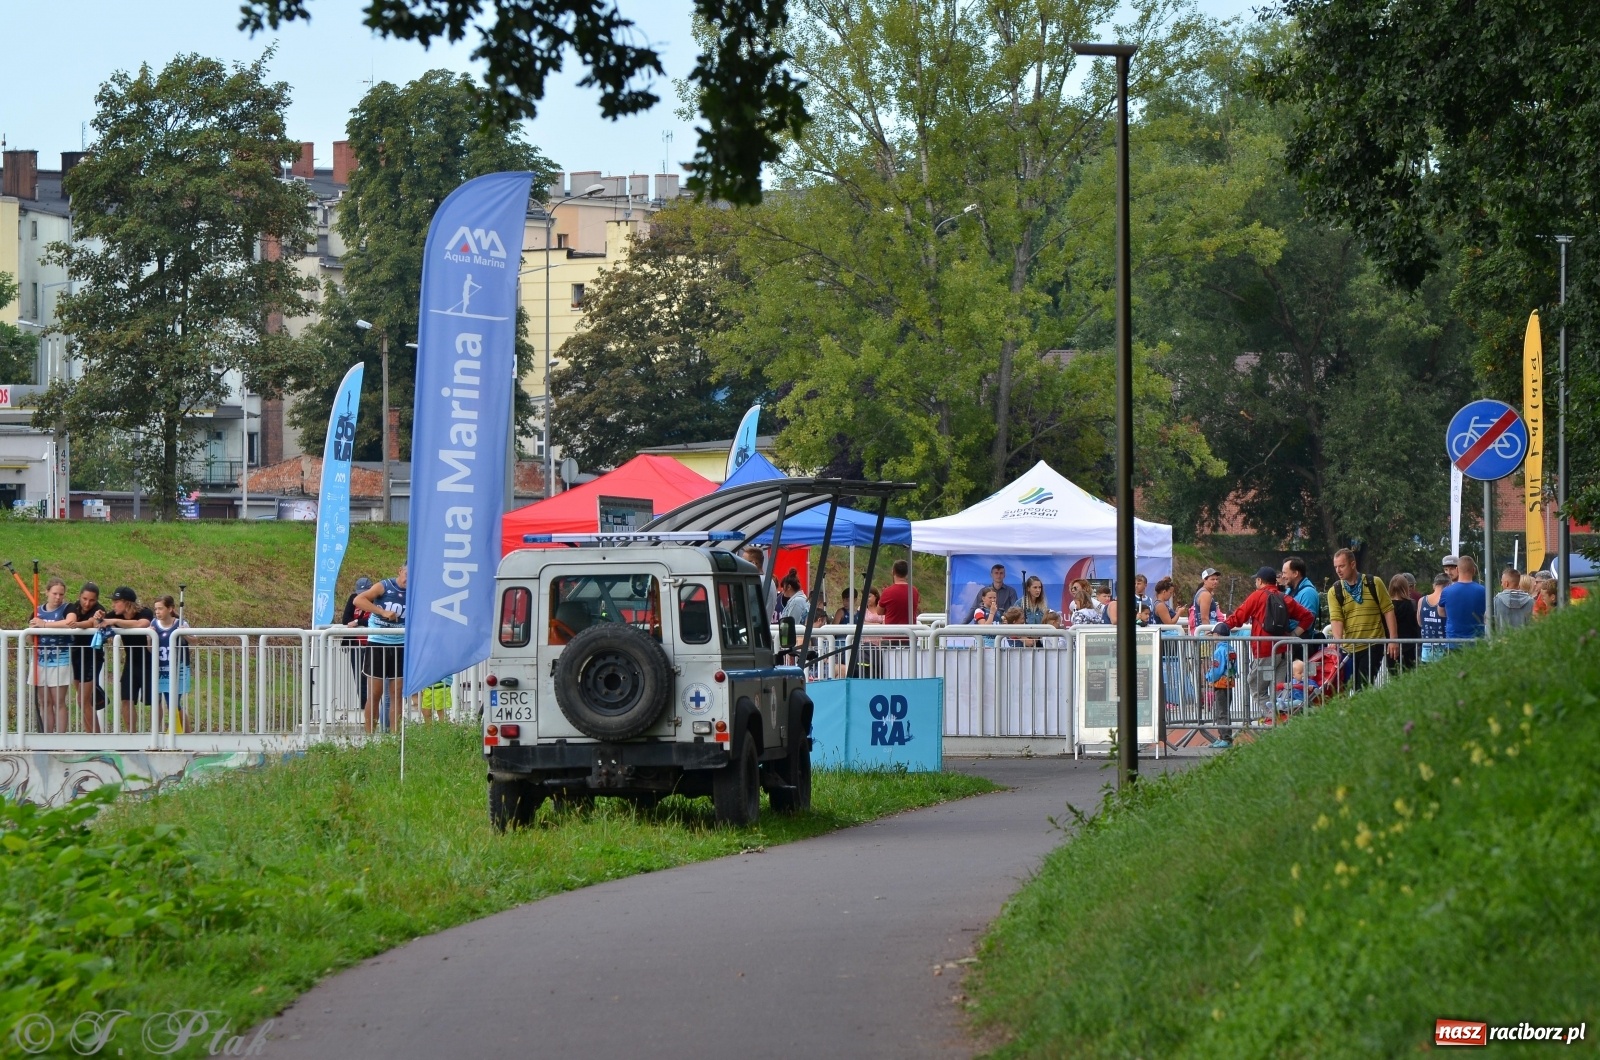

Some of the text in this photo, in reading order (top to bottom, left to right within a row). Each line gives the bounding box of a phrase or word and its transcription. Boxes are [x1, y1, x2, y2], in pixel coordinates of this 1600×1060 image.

[443, 252, 505, 269] Aqua Marina
[429, 332, 483, 626] Aqua Marina
[499, 691, 529, 706] SRC
[494, 706, 532, 721] 4W63
